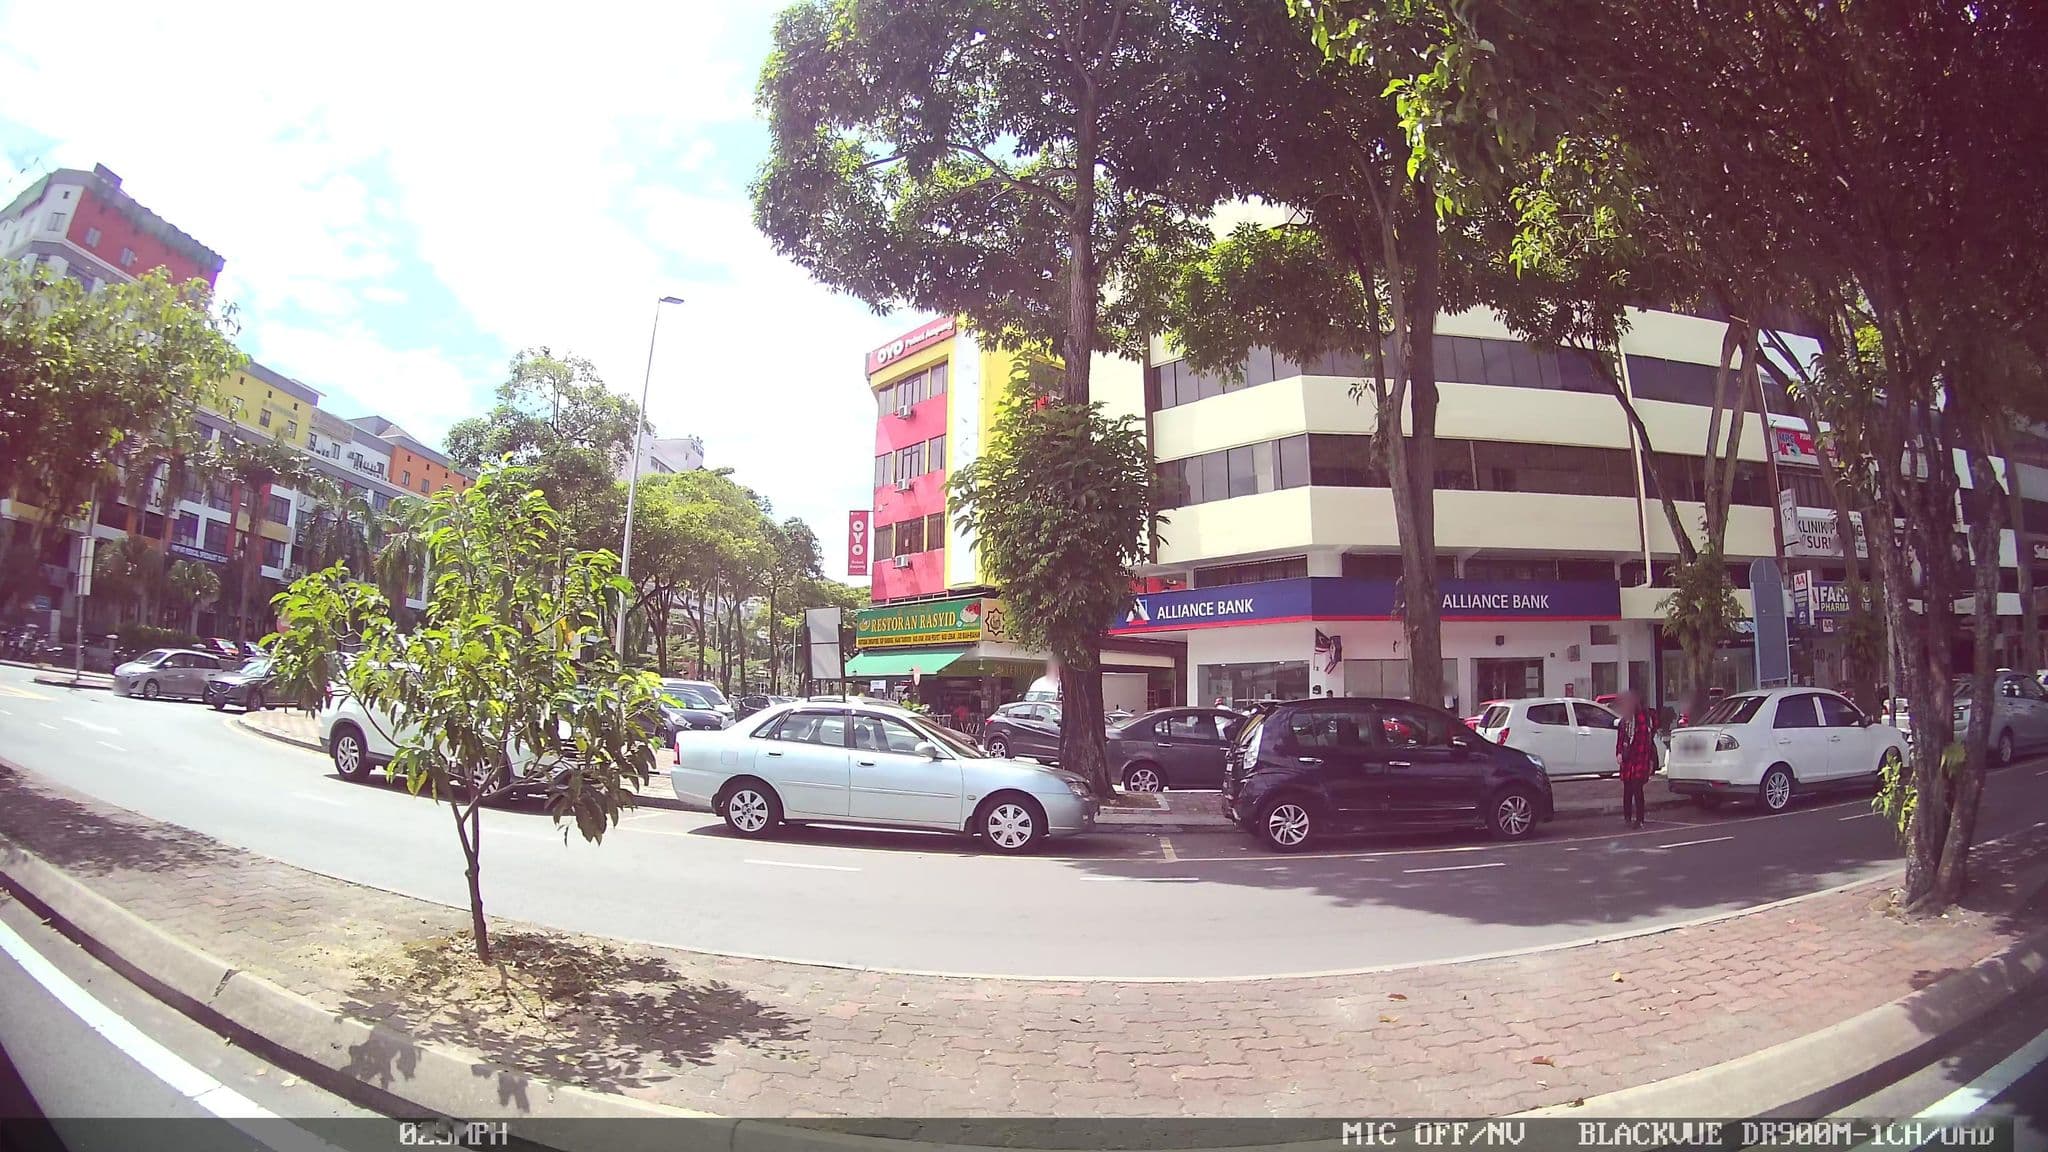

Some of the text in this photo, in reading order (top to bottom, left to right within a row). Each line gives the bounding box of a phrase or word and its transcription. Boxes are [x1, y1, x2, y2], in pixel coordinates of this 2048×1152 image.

[878, 341, 905, 363] OYO
[852, 520, 864, 556] OYO
[1157, 599, 1254, 620] ALLIANCE BANK
[1442, 594, 1549, 609] ALLIANCE BANK
[871, 611, 956, 632] RESTORAN RASYID
